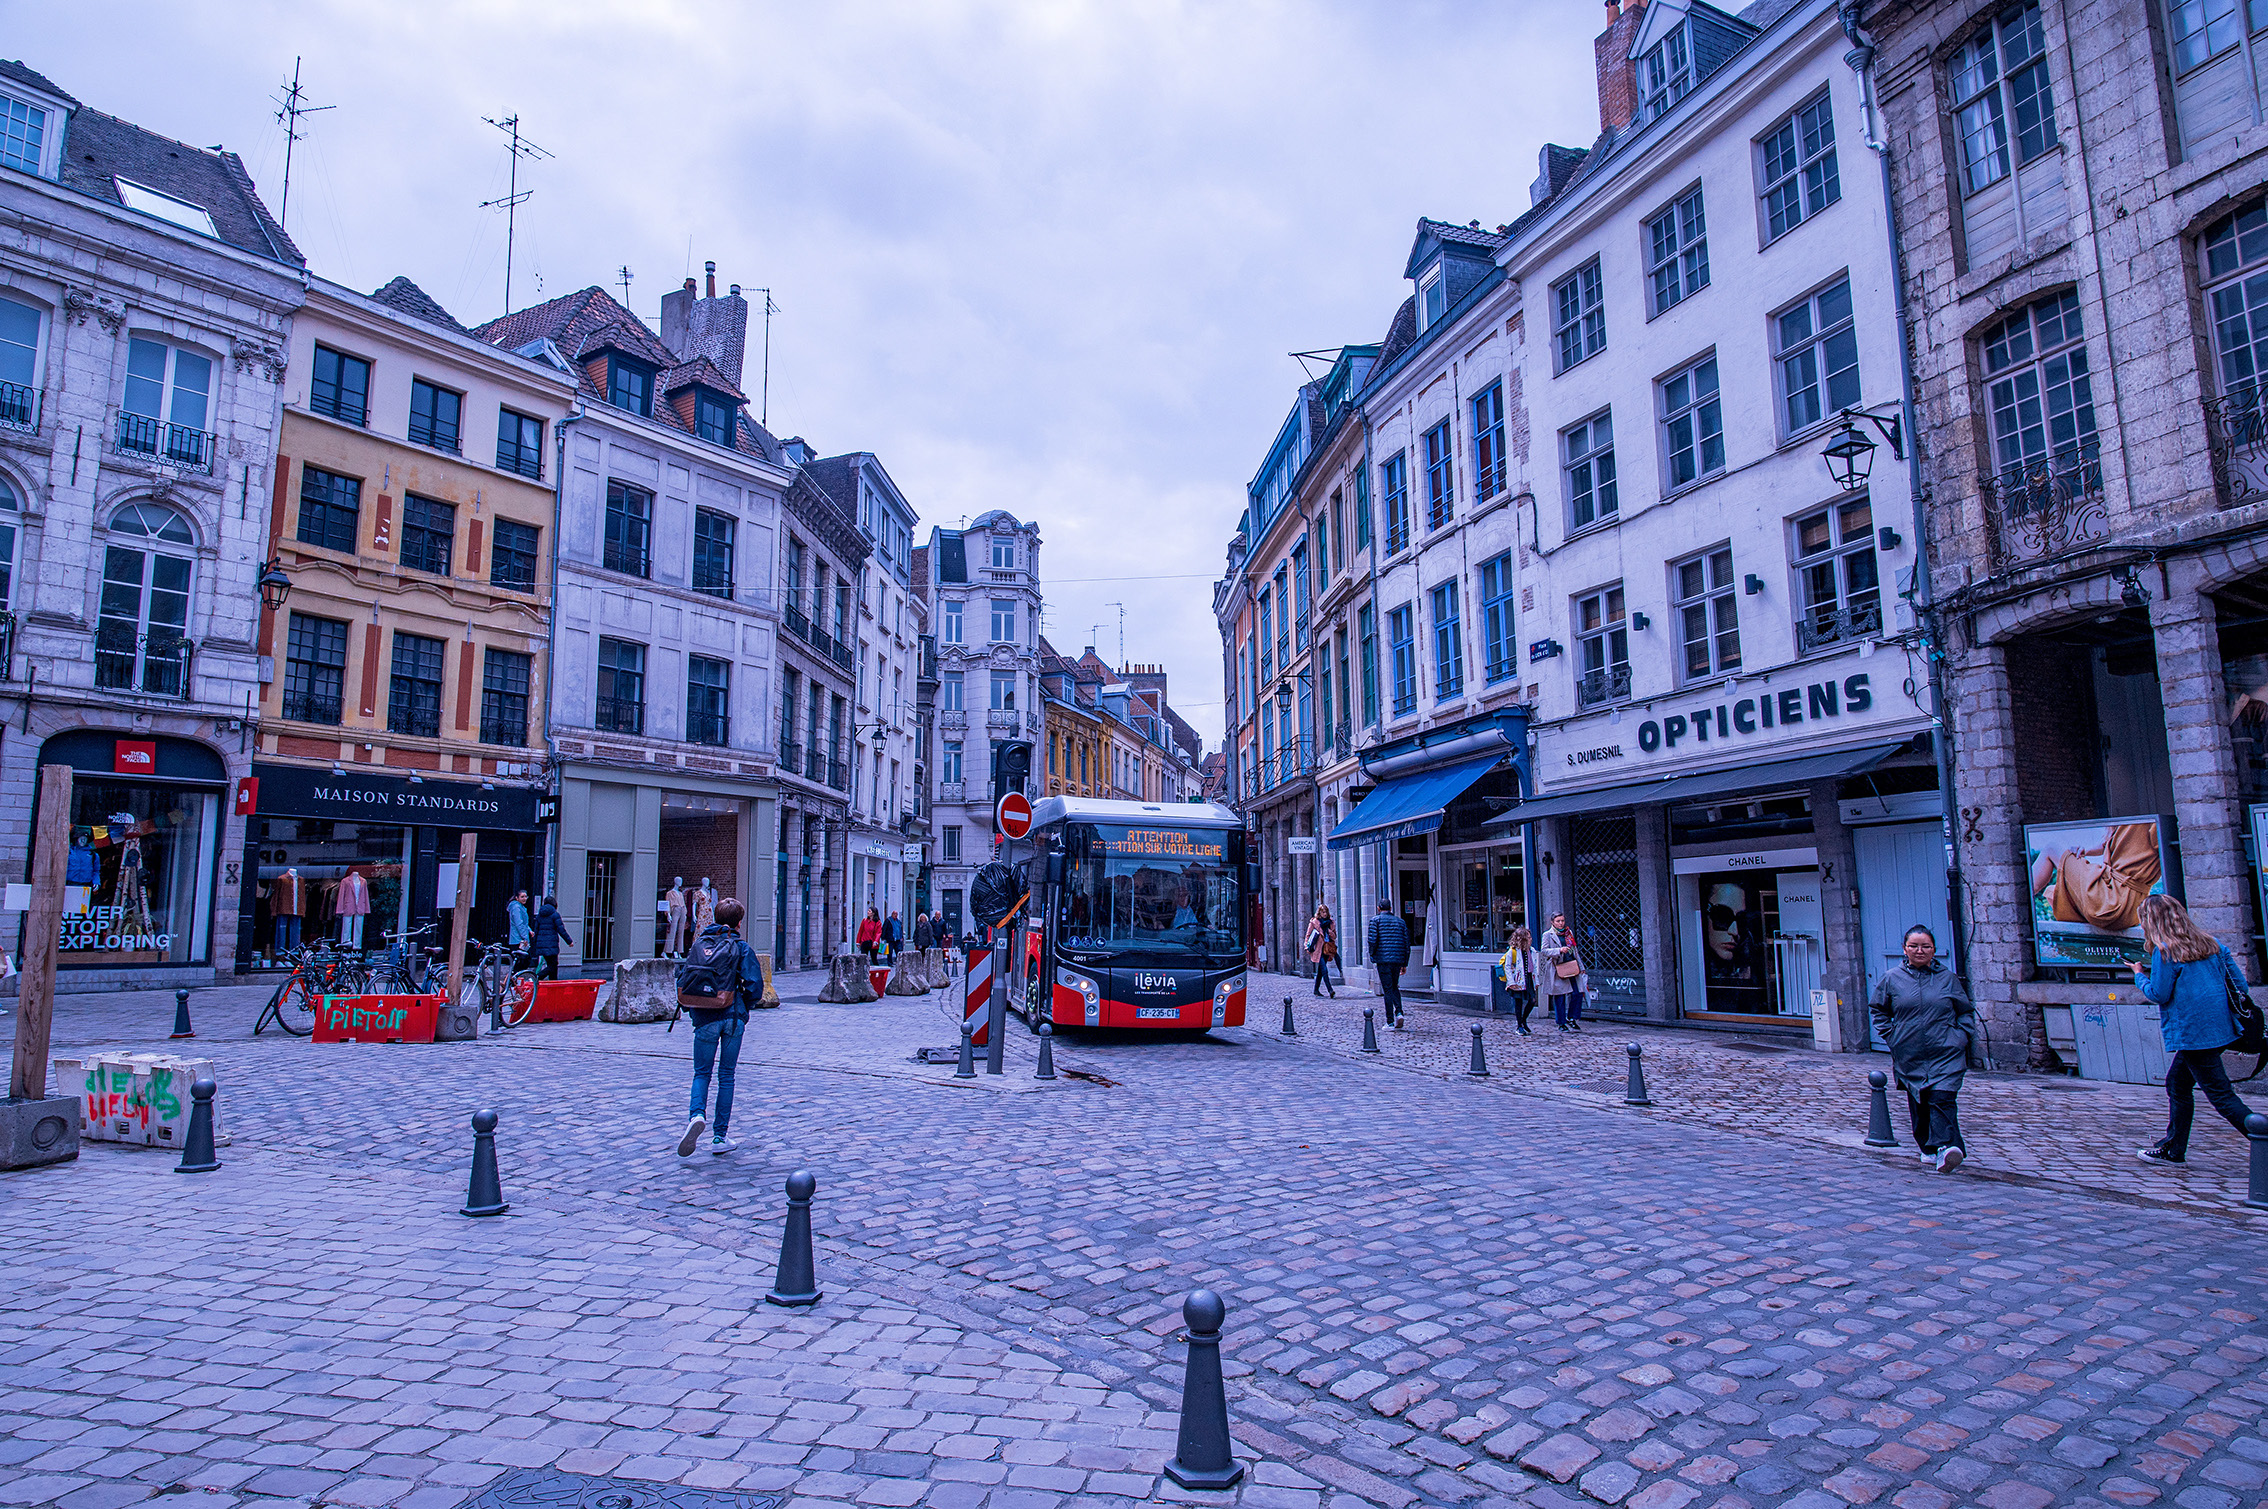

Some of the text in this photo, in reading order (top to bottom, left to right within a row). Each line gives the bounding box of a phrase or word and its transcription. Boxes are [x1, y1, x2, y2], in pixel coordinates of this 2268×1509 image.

[1638, 673, 1872, 752] OPTICIENS
[1567, 744, 1624, 767] S. DUMESNIL
[313, 787, 499, 813] MAISON STANDARDS
[1127, 829, 1188, 844] ATTENTION
[1145, 842, 1163, 854] SUR
[1164, 843, 1194, 855] VOTRE
[1195, 844, 1222, 857] LIGNE
[1728, 856, 1767, 867] CHANEL
[1783, 895, 1815, 903] CHANEL
[1140, 1009, 1175, 1018] CF-235-CT
